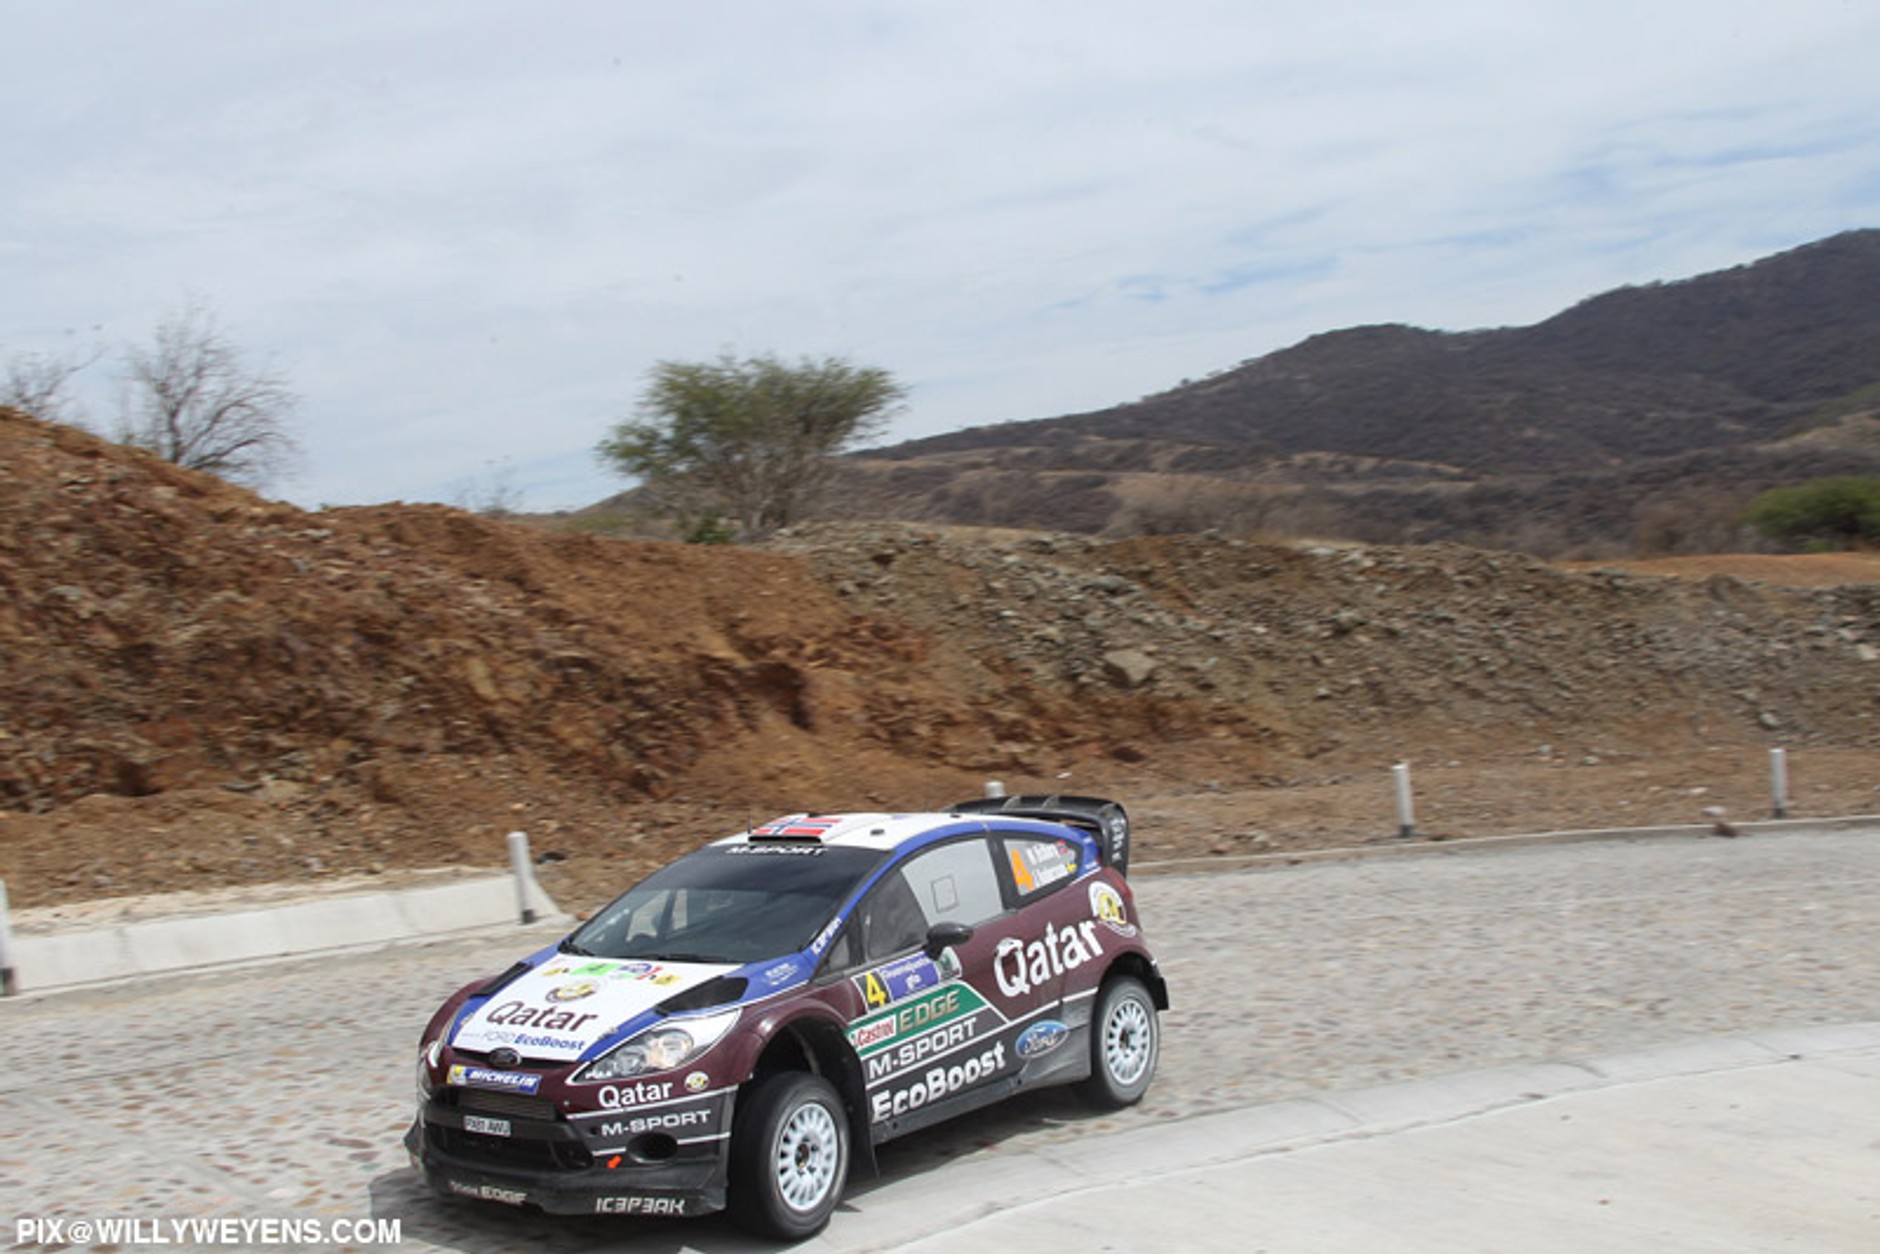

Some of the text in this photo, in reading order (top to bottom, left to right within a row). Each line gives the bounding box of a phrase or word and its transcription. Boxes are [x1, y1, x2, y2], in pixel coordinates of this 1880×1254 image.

[1011, 848, 1035, 891] 4
[993, 921, 1105, 998] Qatar
[866, 972, 887, 1006] 4
[486, 1000, 598, 1032] Qatar
[899, 989, 960, 1033] EDGE
[514, 1032, 586, 1050] EcoBoost
[868, 1017, 978, 1080] M-SPORT
[468, 1069, 539, 1088] MICHELIN
[598, 1081, 674, 1109] Qatar
[871, 1041, 1007, 1124] EcoBoost
[601, 1109, 711, 1137] M-SPORT
